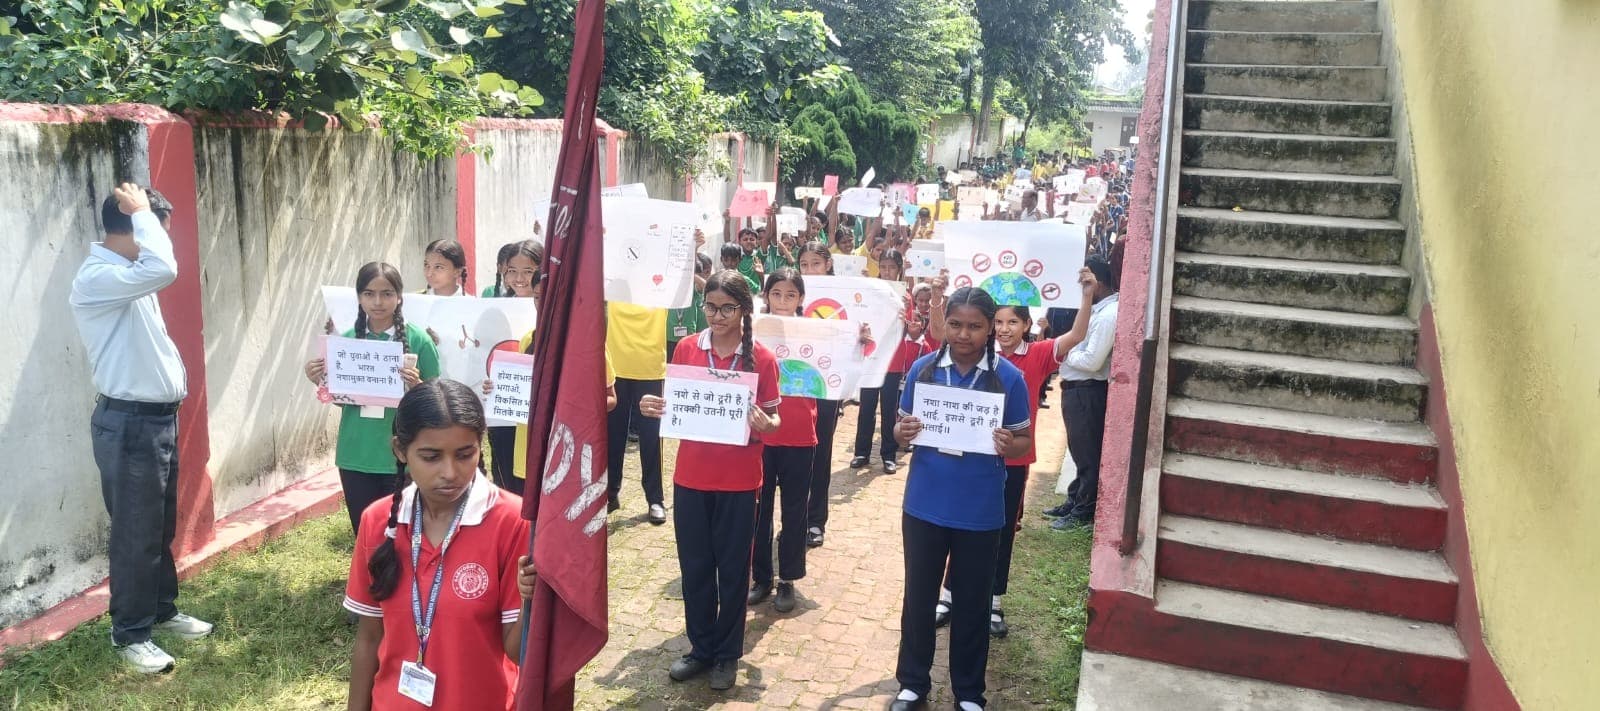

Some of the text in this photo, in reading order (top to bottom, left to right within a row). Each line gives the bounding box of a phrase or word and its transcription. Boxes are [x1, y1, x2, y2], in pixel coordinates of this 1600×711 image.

[358, 364, 374, 373] भारत
[495, 394, 522, 406] विकसित
[673, 388, 688, 400] नशे
[692, 390, 700, 400] से
[704, 391, 714, 402] जो
[718, 393, 732, 406] दूरी
[672, 403, 744, 420] तरक्की उतनी पूरी
[923, 398, 940, 408] नशा
[942, 400, 960, 410] नाश
[962, 402, 974, 412] की
[945, 412, 966, 424] इससे
[970, 416, 984, 428] दूरी
[989, 418, 998, 428] ही
